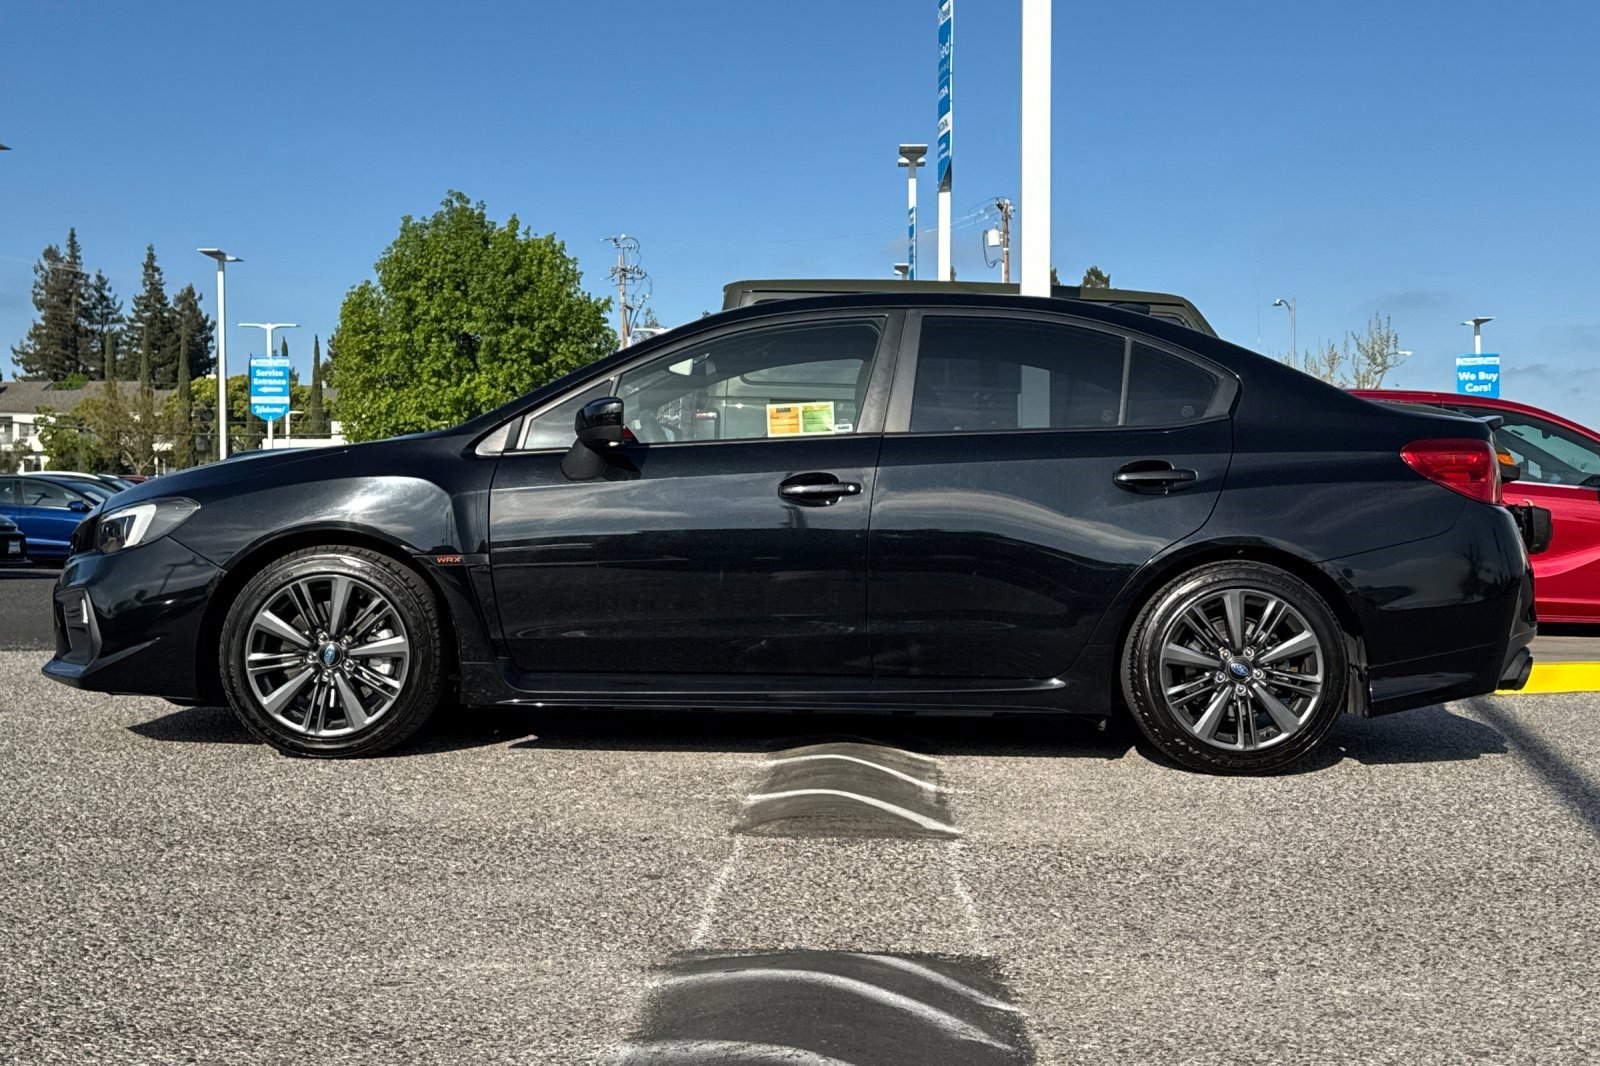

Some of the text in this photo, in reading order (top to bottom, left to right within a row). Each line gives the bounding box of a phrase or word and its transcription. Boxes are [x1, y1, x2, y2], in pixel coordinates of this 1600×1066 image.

[255, 369, 284, 377] Service
[1458, 371, 1499, 383] We Buy
[253, 377, 287, 385] Entrance
[1465, 382, 1492, 393] Cars!
